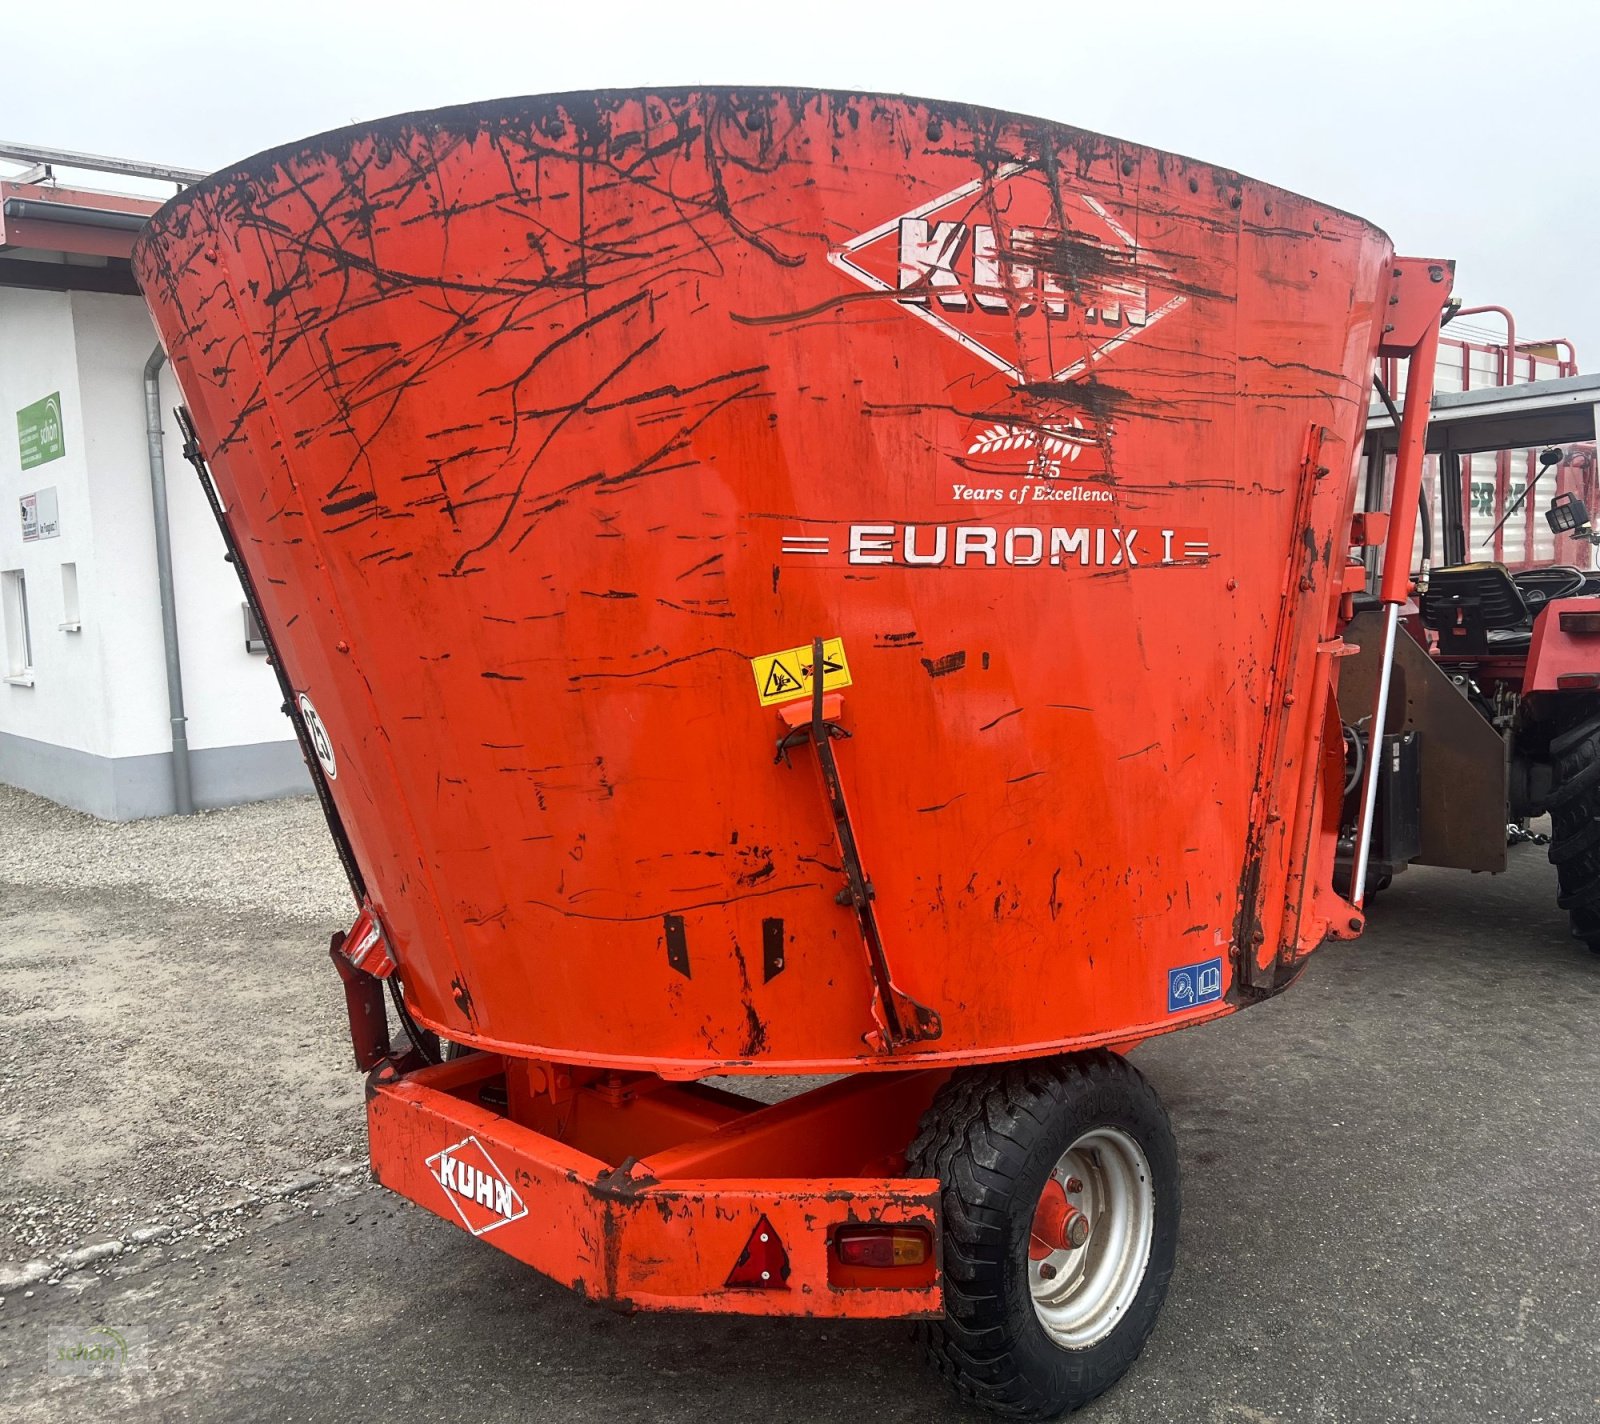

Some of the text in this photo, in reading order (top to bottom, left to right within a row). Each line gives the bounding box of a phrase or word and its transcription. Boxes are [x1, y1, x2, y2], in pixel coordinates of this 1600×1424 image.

[952, 485, 1004, 502] Years
[1009, 485, 1030, 504] of
[848, 524, 1174, 566] EUROMIX I
[440, 1152, 512, 1219] KUHN
